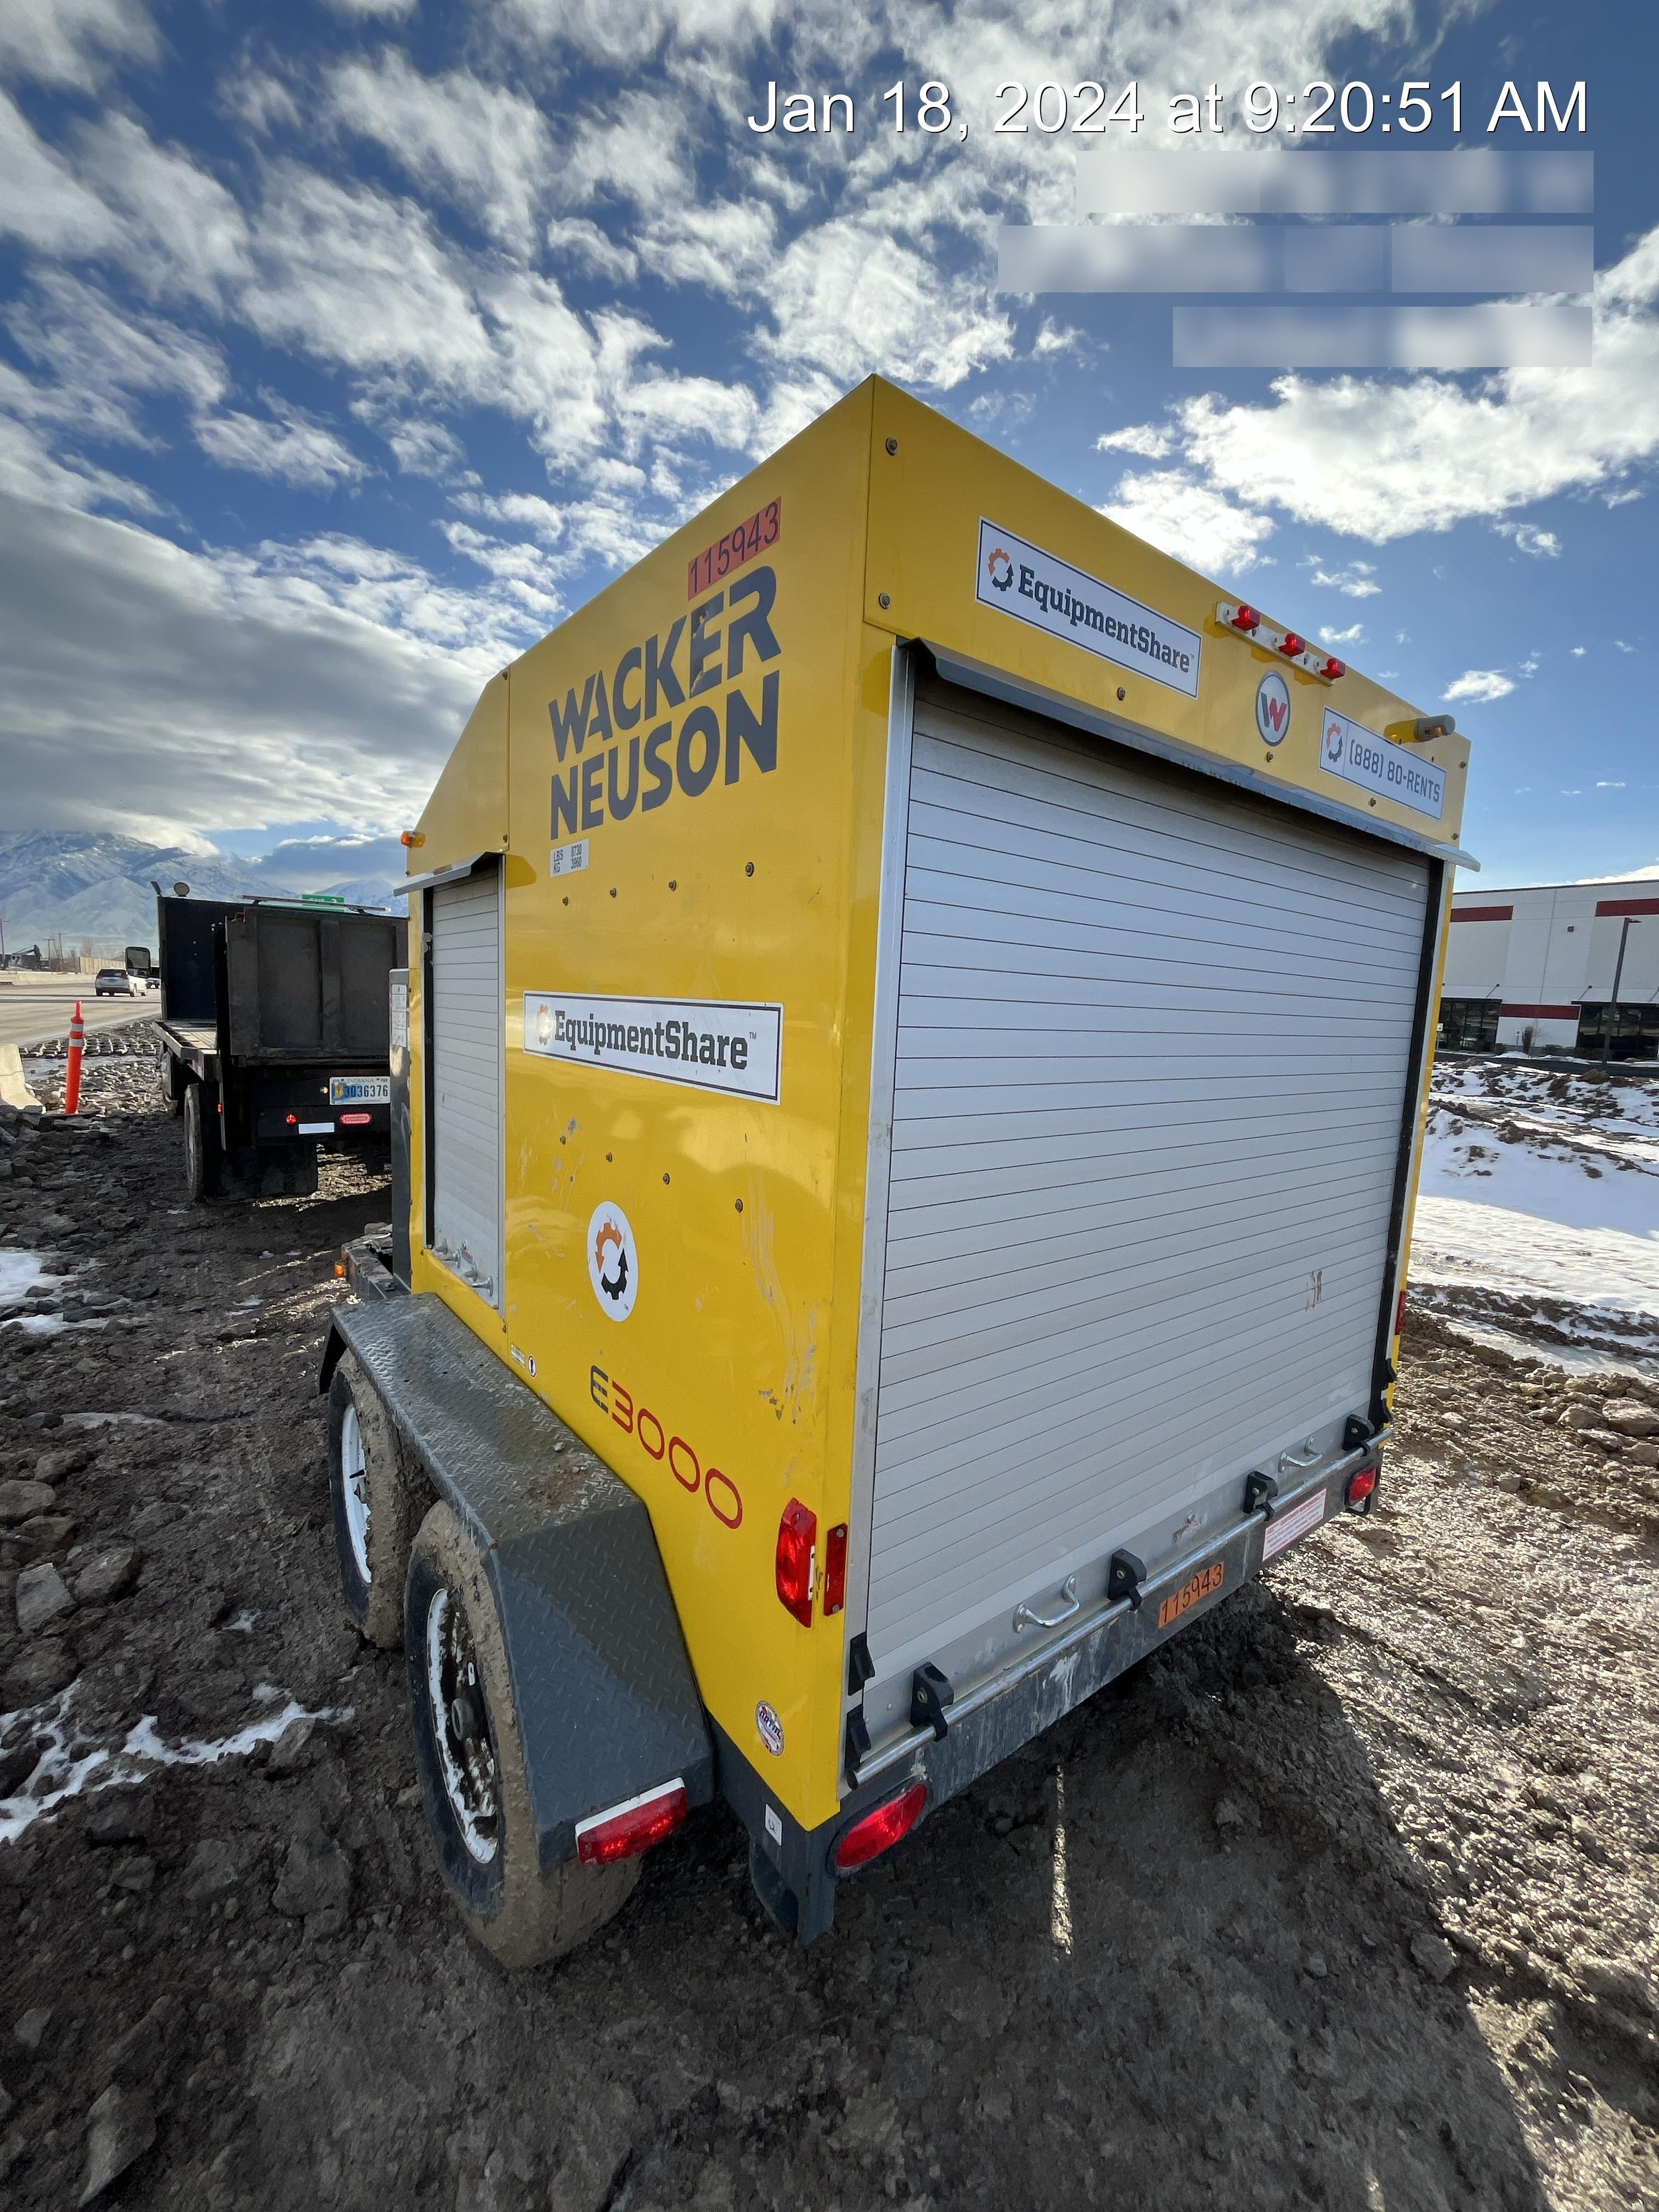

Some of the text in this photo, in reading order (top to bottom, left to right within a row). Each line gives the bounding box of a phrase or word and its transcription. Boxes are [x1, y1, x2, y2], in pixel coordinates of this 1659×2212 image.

[691, 501, 778, 593] 115943
[1018, 564, 1189, 673] EquipmentShare
[549, 566, 781, 763] WACKER
[550, 670, 780, 840] NEUSON
[1350, 739, 1440, 803] (888) 80-RENTS
[554, 844, 582, 862] LBS 8730
[554, 862, 560, 873] KG
[554, 1010, 748, 1070] EquipmentShare
[345, 1085, 388, 1097] 3036376
[591, 1365, 743, 1530] E3000
[1162, 1564, 1222, 1623] 115943
